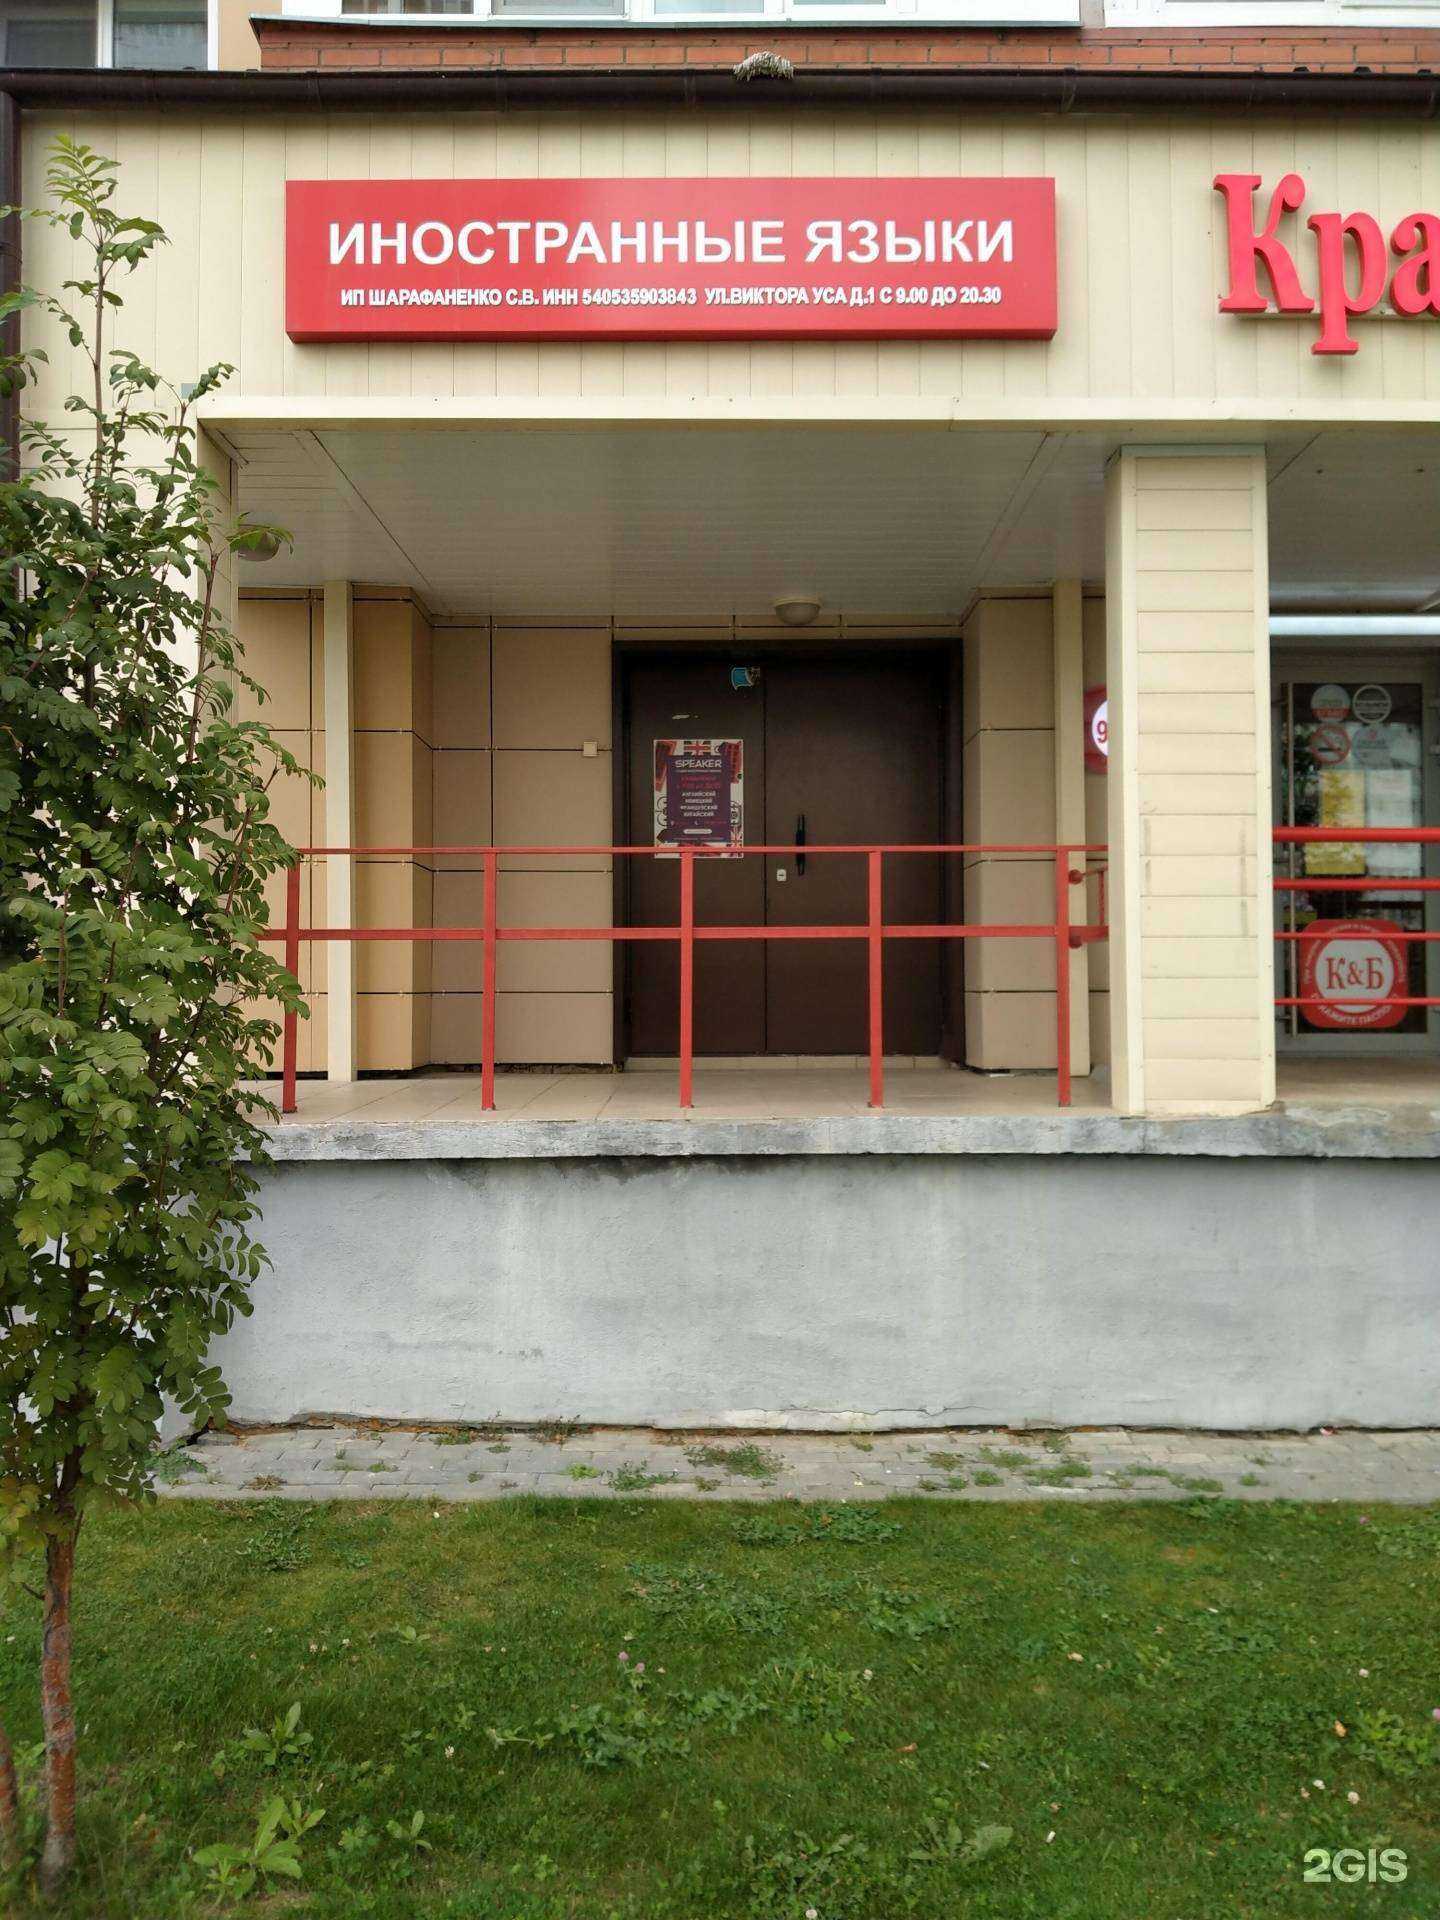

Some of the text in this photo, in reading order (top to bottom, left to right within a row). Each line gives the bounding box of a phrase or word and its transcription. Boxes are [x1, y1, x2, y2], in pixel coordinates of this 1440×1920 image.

[328, 218, 1014, 265] ИНОСТРАННЫЕ ЯЗЫКИ
[1213, 173, 1440, 355] Кра
[341, 289, 365, 306] ИП
[368, 288, 502, 306] ШАРАФАНЕНКО
[505, 288, 540, 305] С.В.
[542, 288, 578, 305] ИНН
[582, 288, 697, 304] 540535903843
[812, 287, 847, 304] УСА
[879, 287, 893, 304] С
[895, 287, 929, 304] 9.00
[931, 287, 957, 306] ДО
[959, 287, 1002, 304] 20.30
[675, 759, 723, 768] SPEAKER
[1310, 993, 1357, 1025] ПКАЖИТЕ
